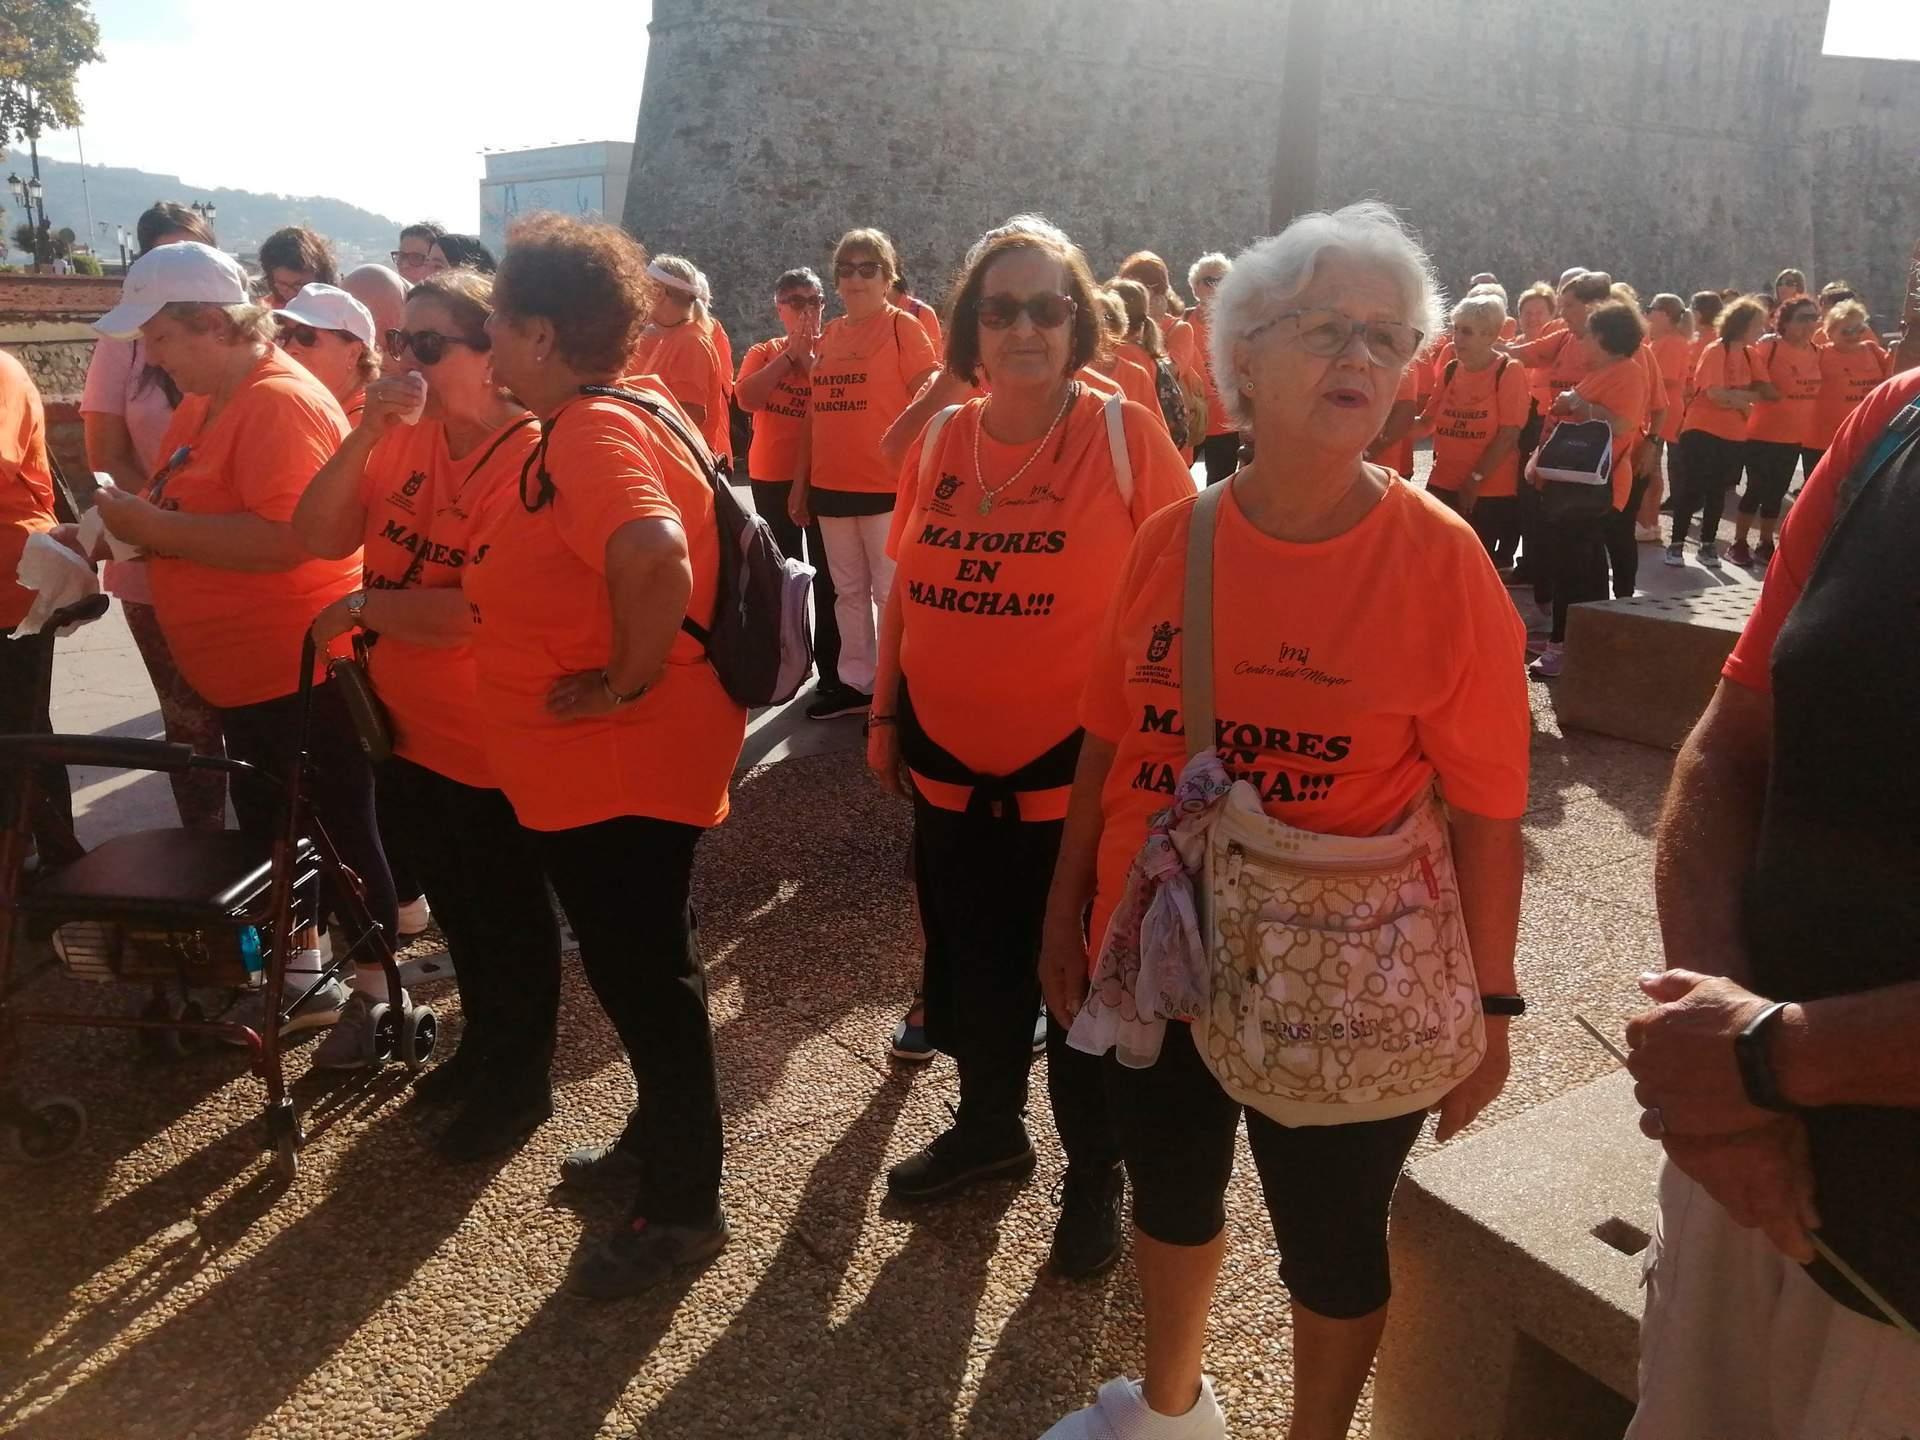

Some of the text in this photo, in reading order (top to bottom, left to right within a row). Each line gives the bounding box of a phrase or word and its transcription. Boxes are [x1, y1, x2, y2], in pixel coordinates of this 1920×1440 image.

[813, 373, 868, 386] MAYORES
[829, 387, 845, 398] EN
[814, 400, 868, 412] MARCHA!!!
[918, 524, 1066, 554] MAYORES
[955, 559, 1001, 584] EN
[910, 580, 1054, 616] MARCHA!!!
[1234, 661, 1352, 687] Centro del Mayor
[1139, 704, 1351, 762] MYORES
